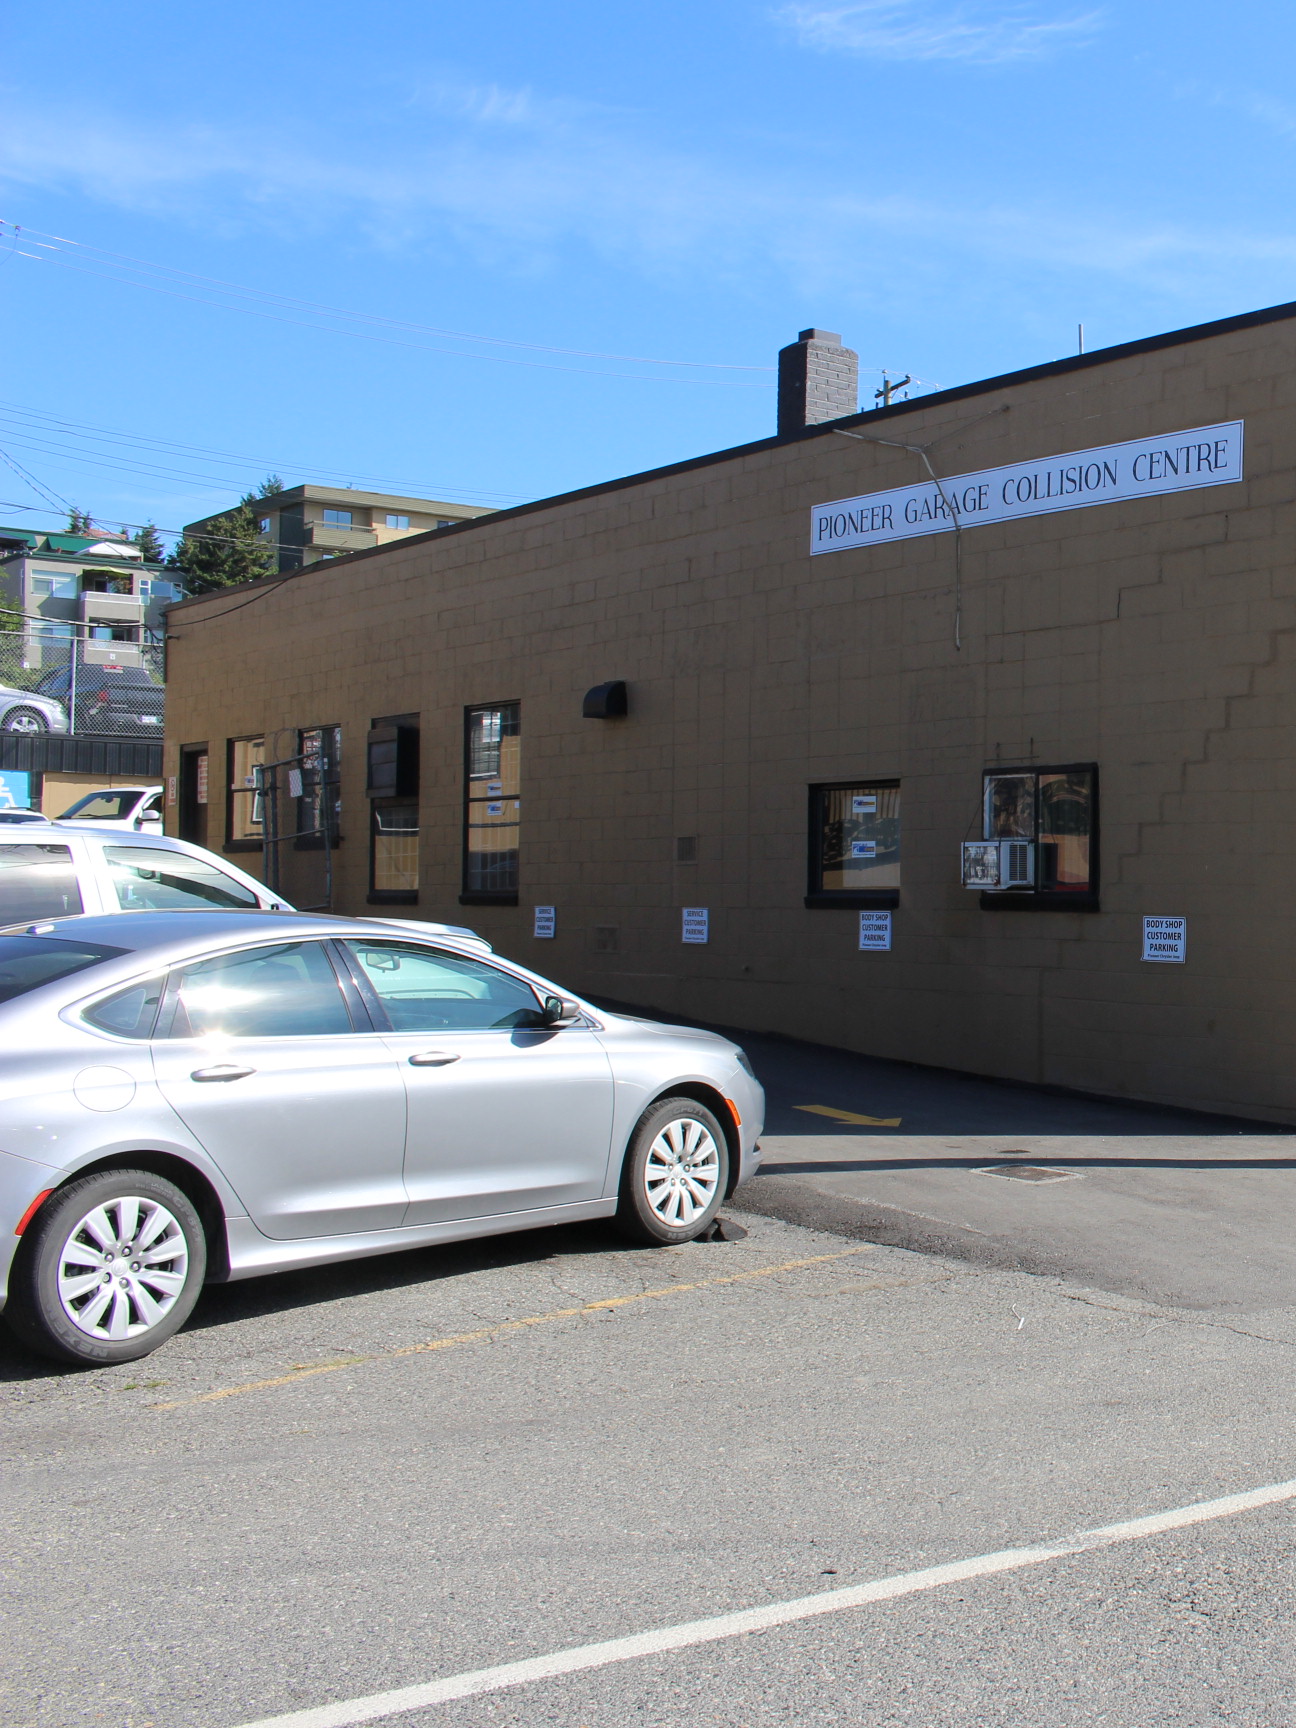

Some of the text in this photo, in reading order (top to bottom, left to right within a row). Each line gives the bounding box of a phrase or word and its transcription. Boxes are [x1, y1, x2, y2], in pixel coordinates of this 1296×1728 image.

[818, 439, 1229, 542] PIONEER GARAGE COLLISION CENTRE
[861, 913, 875, 921] BODY
[862, 923, 888, 931] CUSTOMER
[1146, 919, 1183, 929] BODY SHOP
[685, 928, 705, 936] PARKING
[1146, 931, 1182, 941] CUSTOMER
[863, 933, 886, 941] PARKING
[1149, 943, 1179, 953] PARKING
